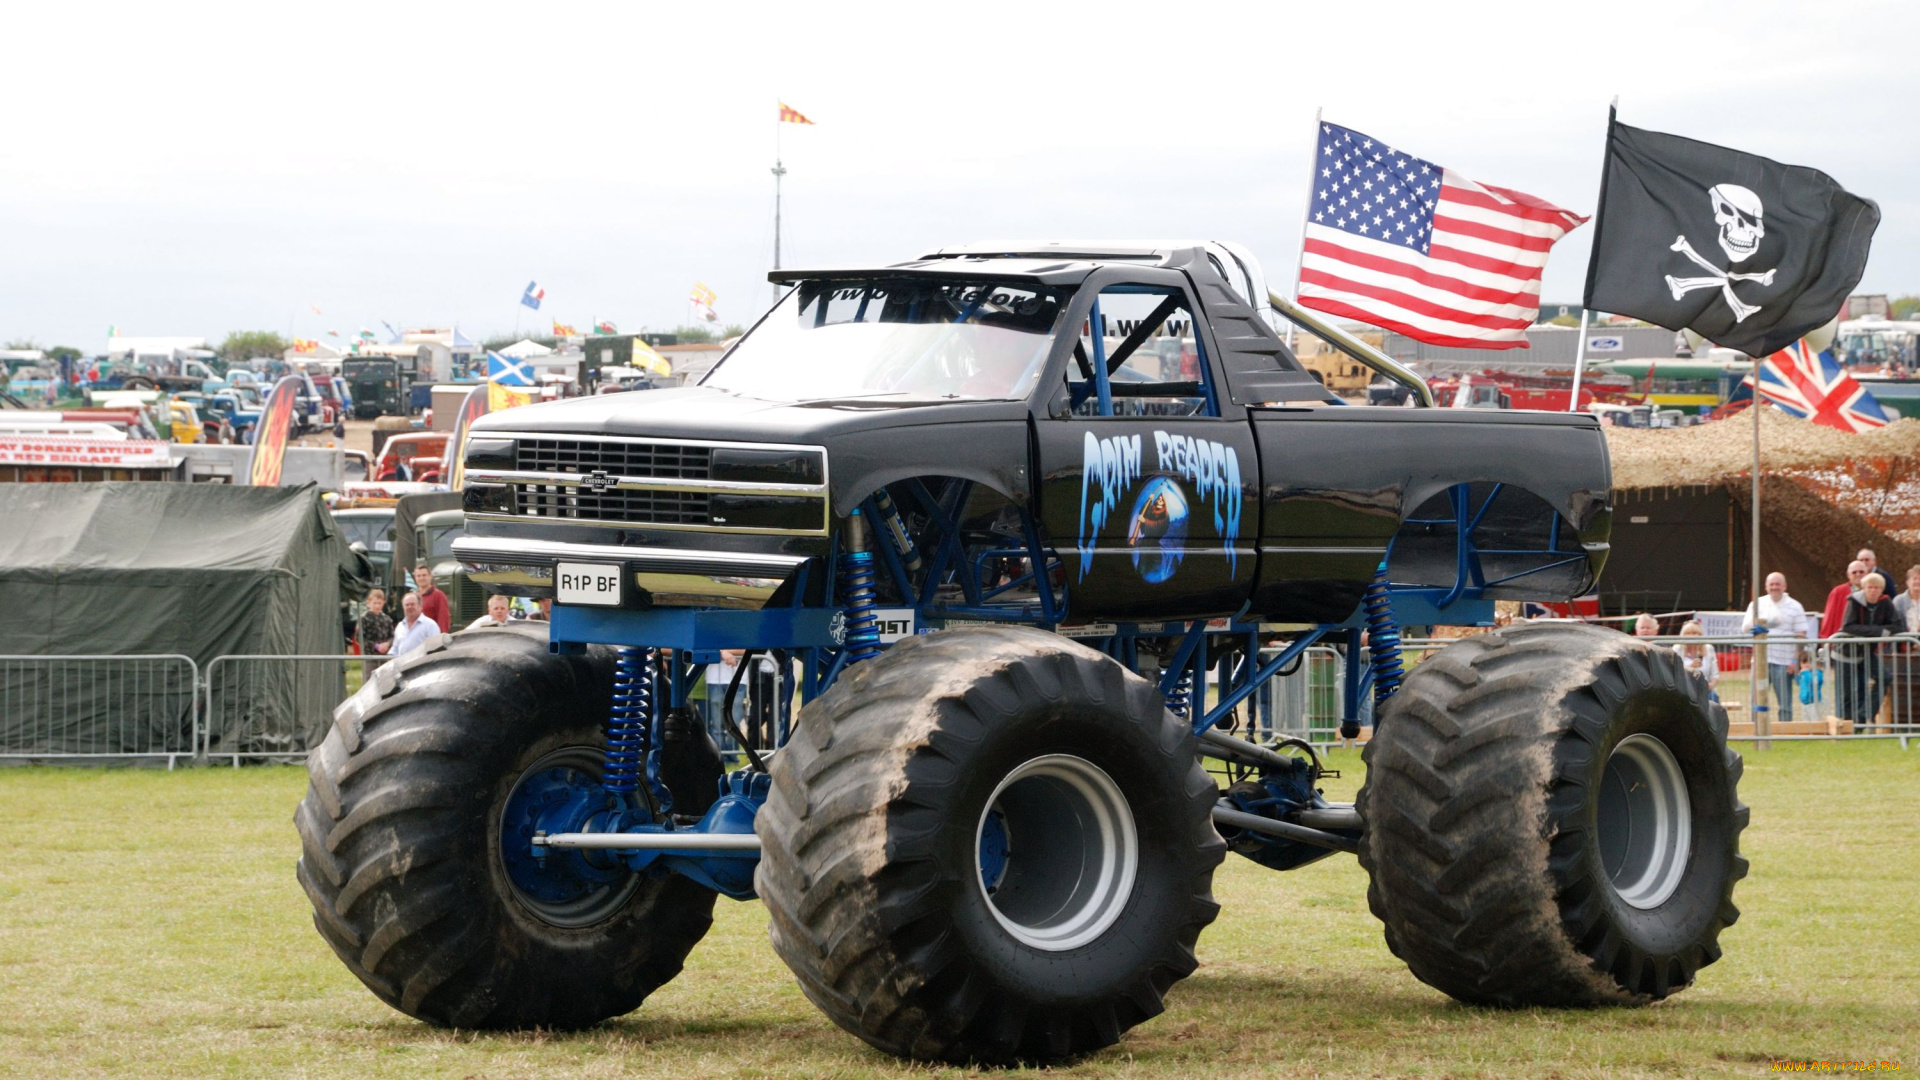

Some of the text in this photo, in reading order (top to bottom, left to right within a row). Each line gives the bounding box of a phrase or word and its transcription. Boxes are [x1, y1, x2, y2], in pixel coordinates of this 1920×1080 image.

[562, 574, 618, 593] R1P BF
[870, 619, 911, 635] OST
[1707, 618, 1732, 627] HELP
